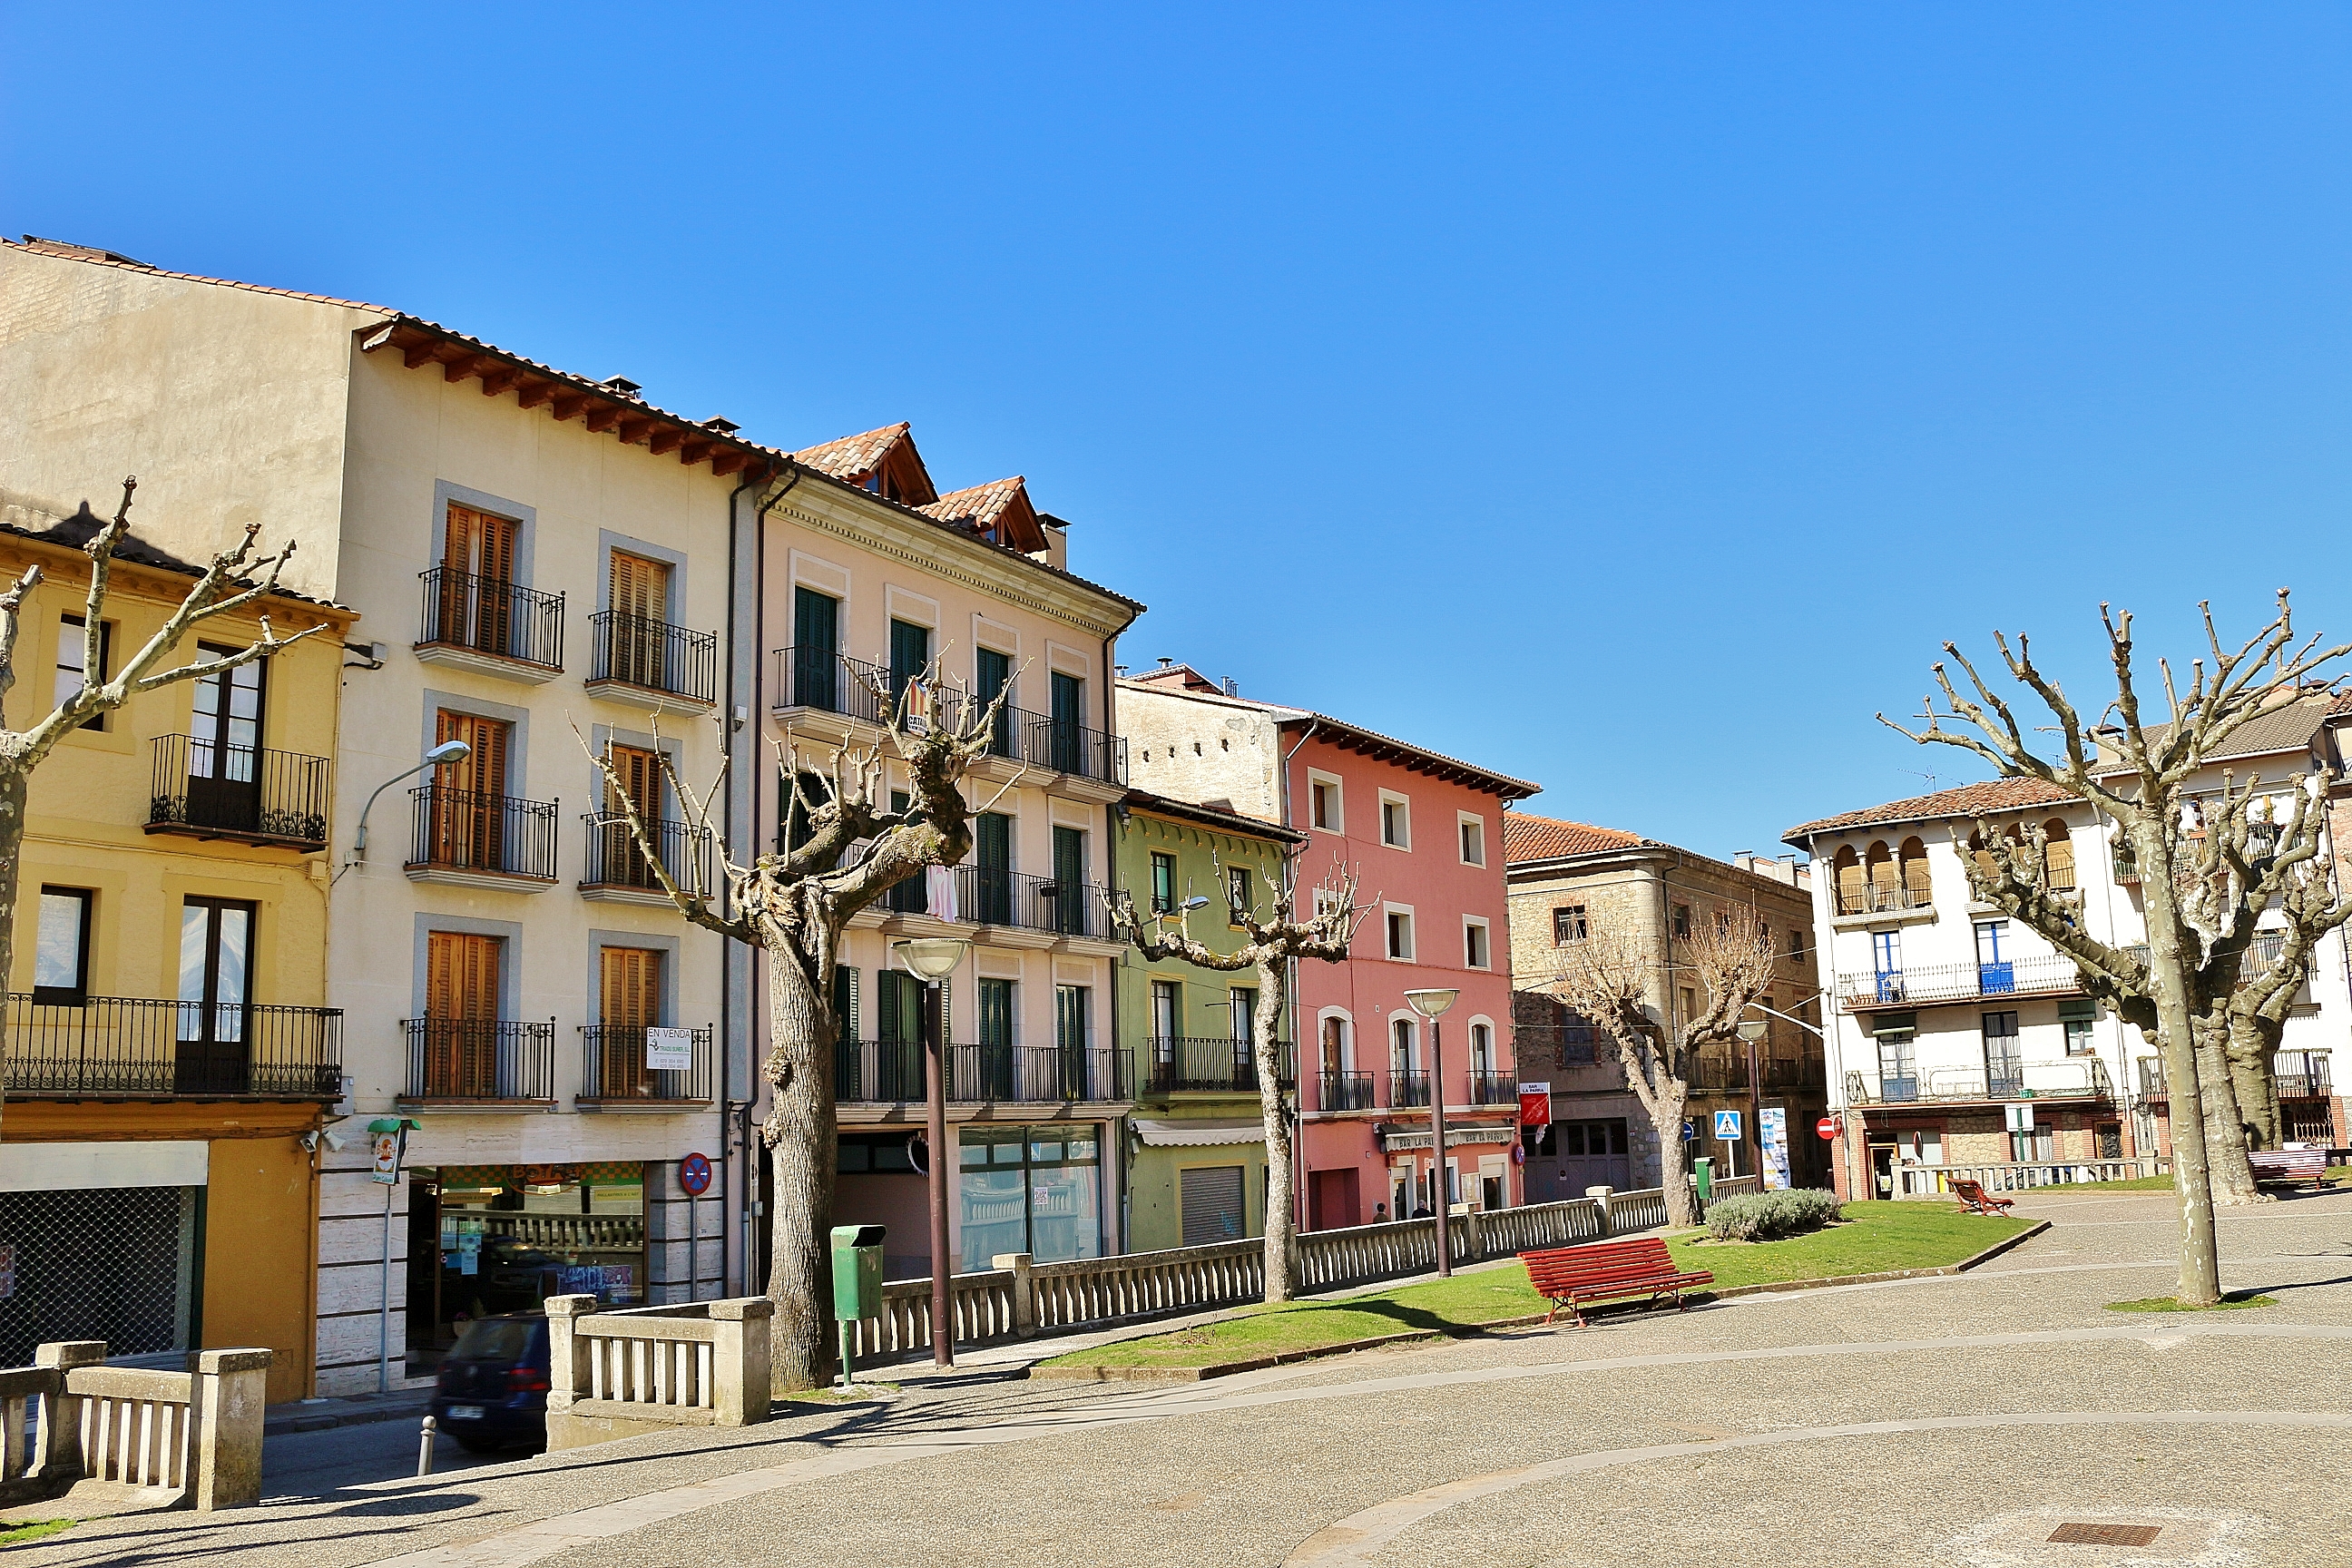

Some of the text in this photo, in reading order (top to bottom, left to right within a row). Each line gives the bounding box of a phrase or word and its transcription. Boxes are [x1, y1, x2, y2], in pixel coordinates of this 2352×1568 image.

[649, 1029, 690, 1038] EN VENDA
[1488, 1132, 1504, 1141] PARRA
[1400, 1138, 1411, 1148] BAR
[1416, 1137, 1422, 1146] LA
